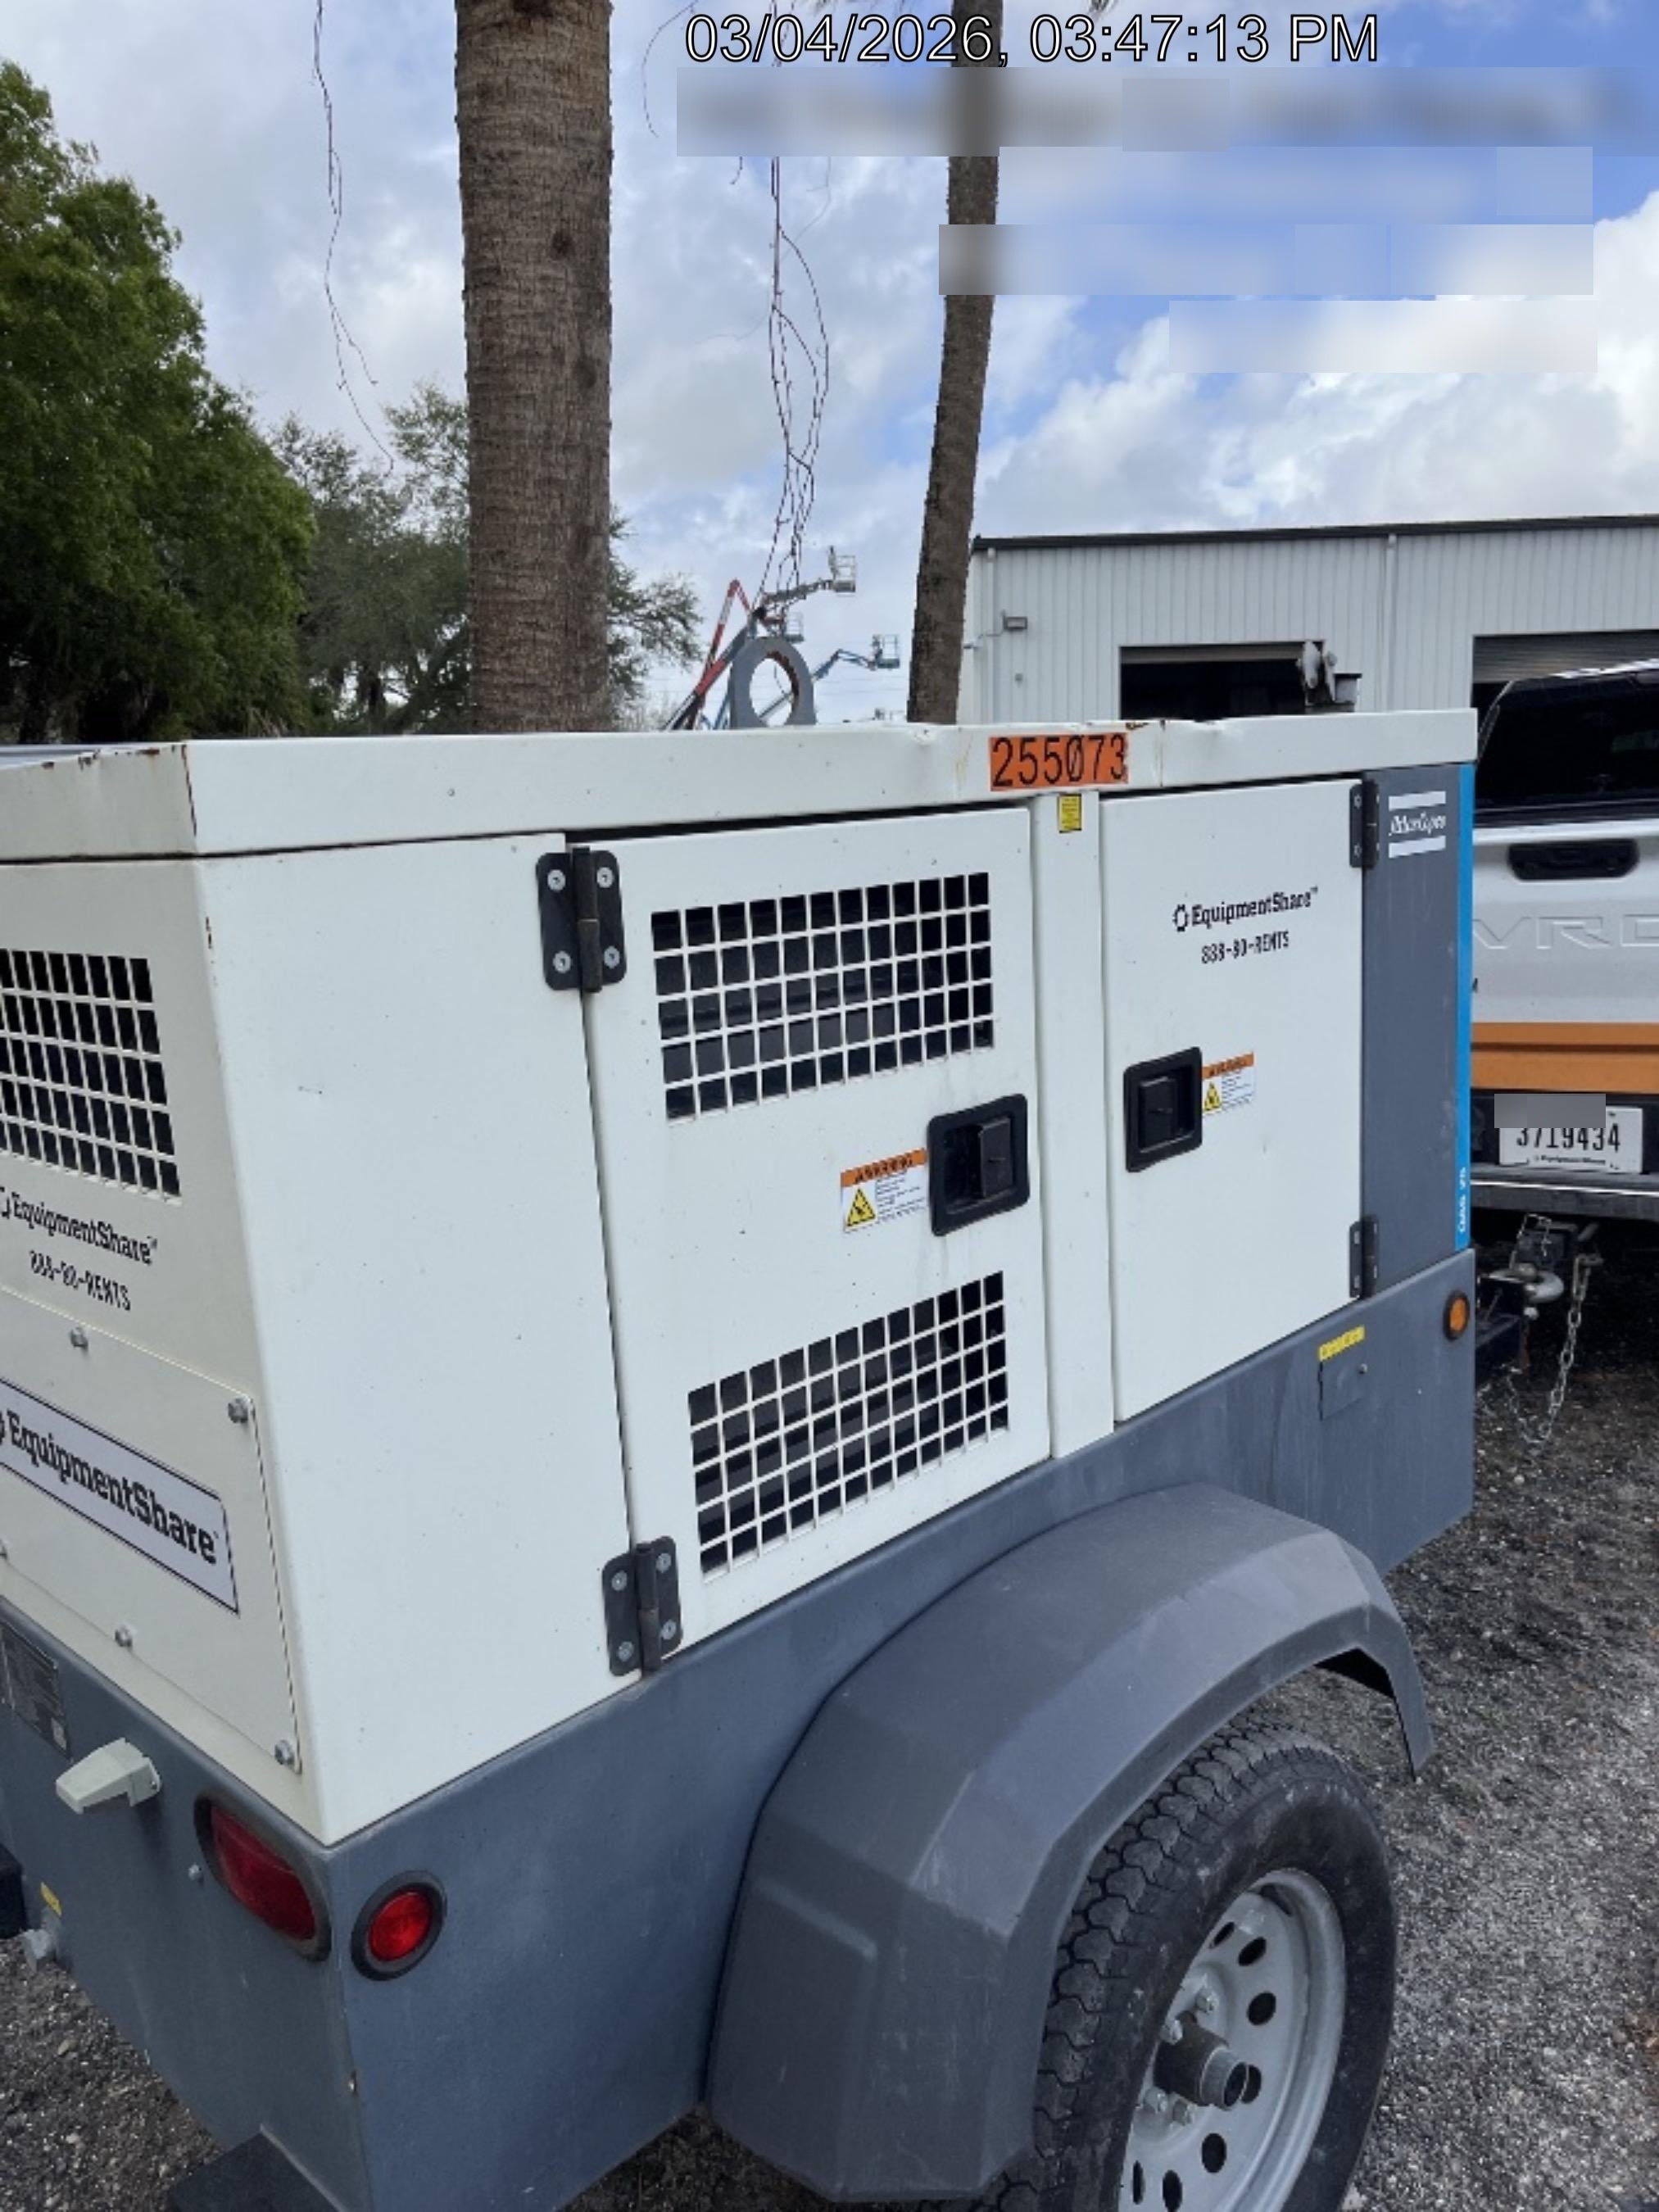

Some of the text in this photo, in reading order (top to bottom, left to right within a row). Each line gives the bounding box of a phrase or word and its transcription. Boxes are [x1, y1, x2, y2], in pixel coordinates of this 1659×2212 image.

[992, 735, 1125, 786] 255073
[11, 1191, 153, 1266] EquipmentShare
[7, 1409, 217, 1566] EquipmentShare
